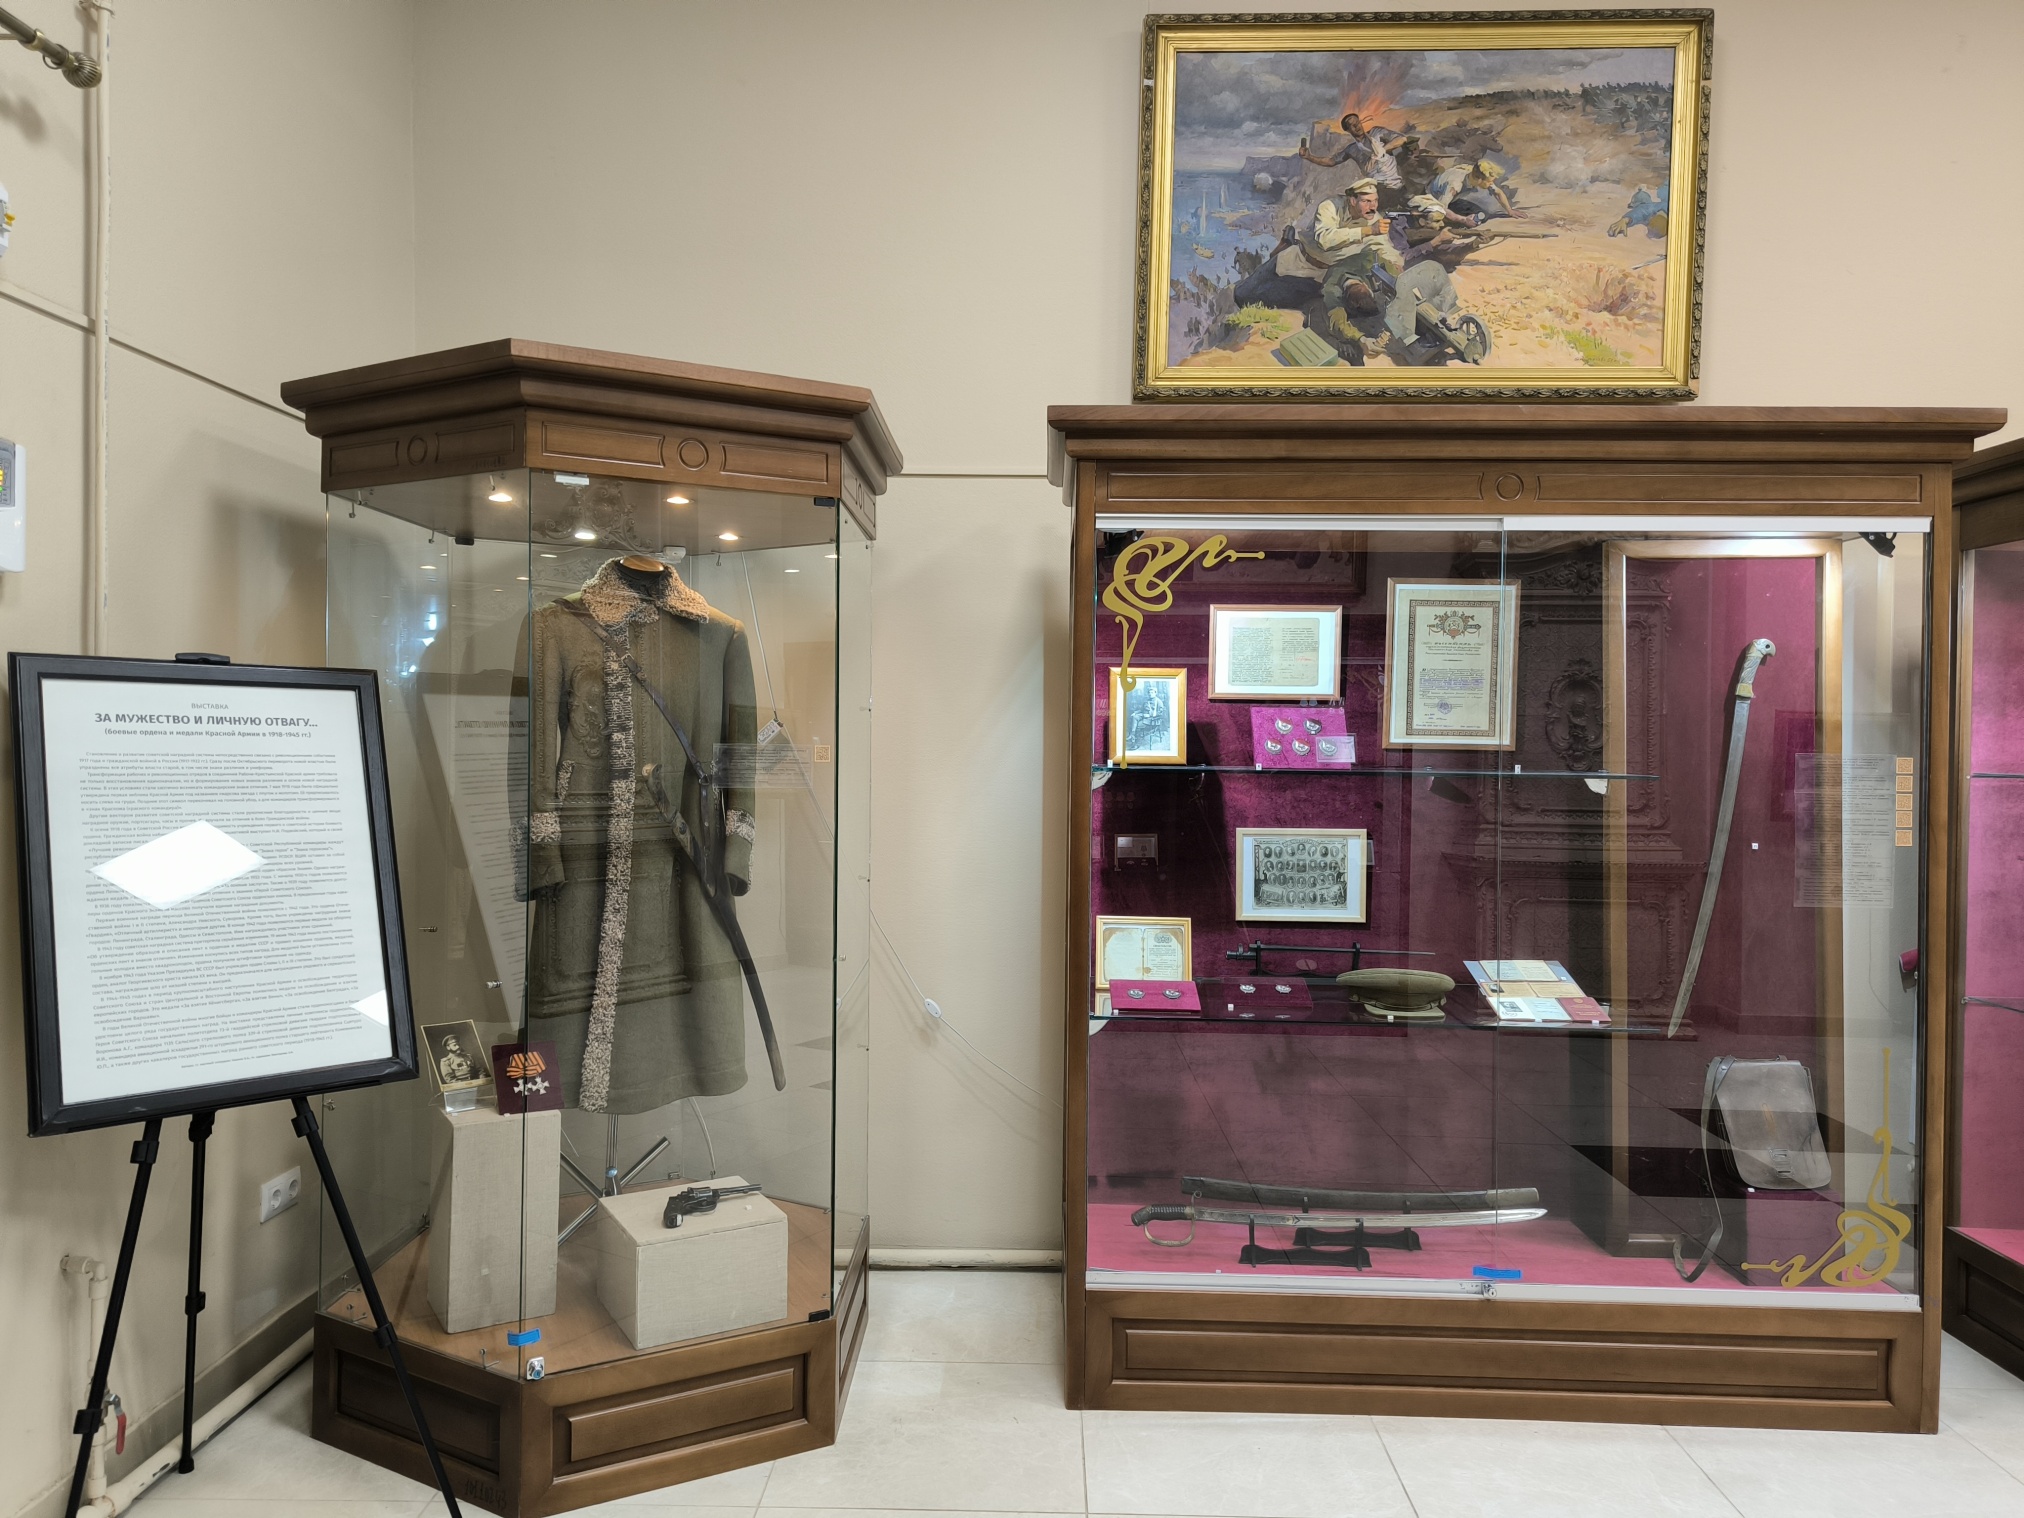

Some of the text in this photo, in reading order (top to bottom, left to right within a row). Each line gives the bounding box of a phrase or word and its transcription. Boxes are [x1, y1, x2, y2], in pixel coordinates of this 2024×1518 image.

[94, 713, 318, 727] ЗА МУЖЕСТВО И ЛИЧНУЮ ОТВАГУ...
[104, 728, 138, 736] (боевые
